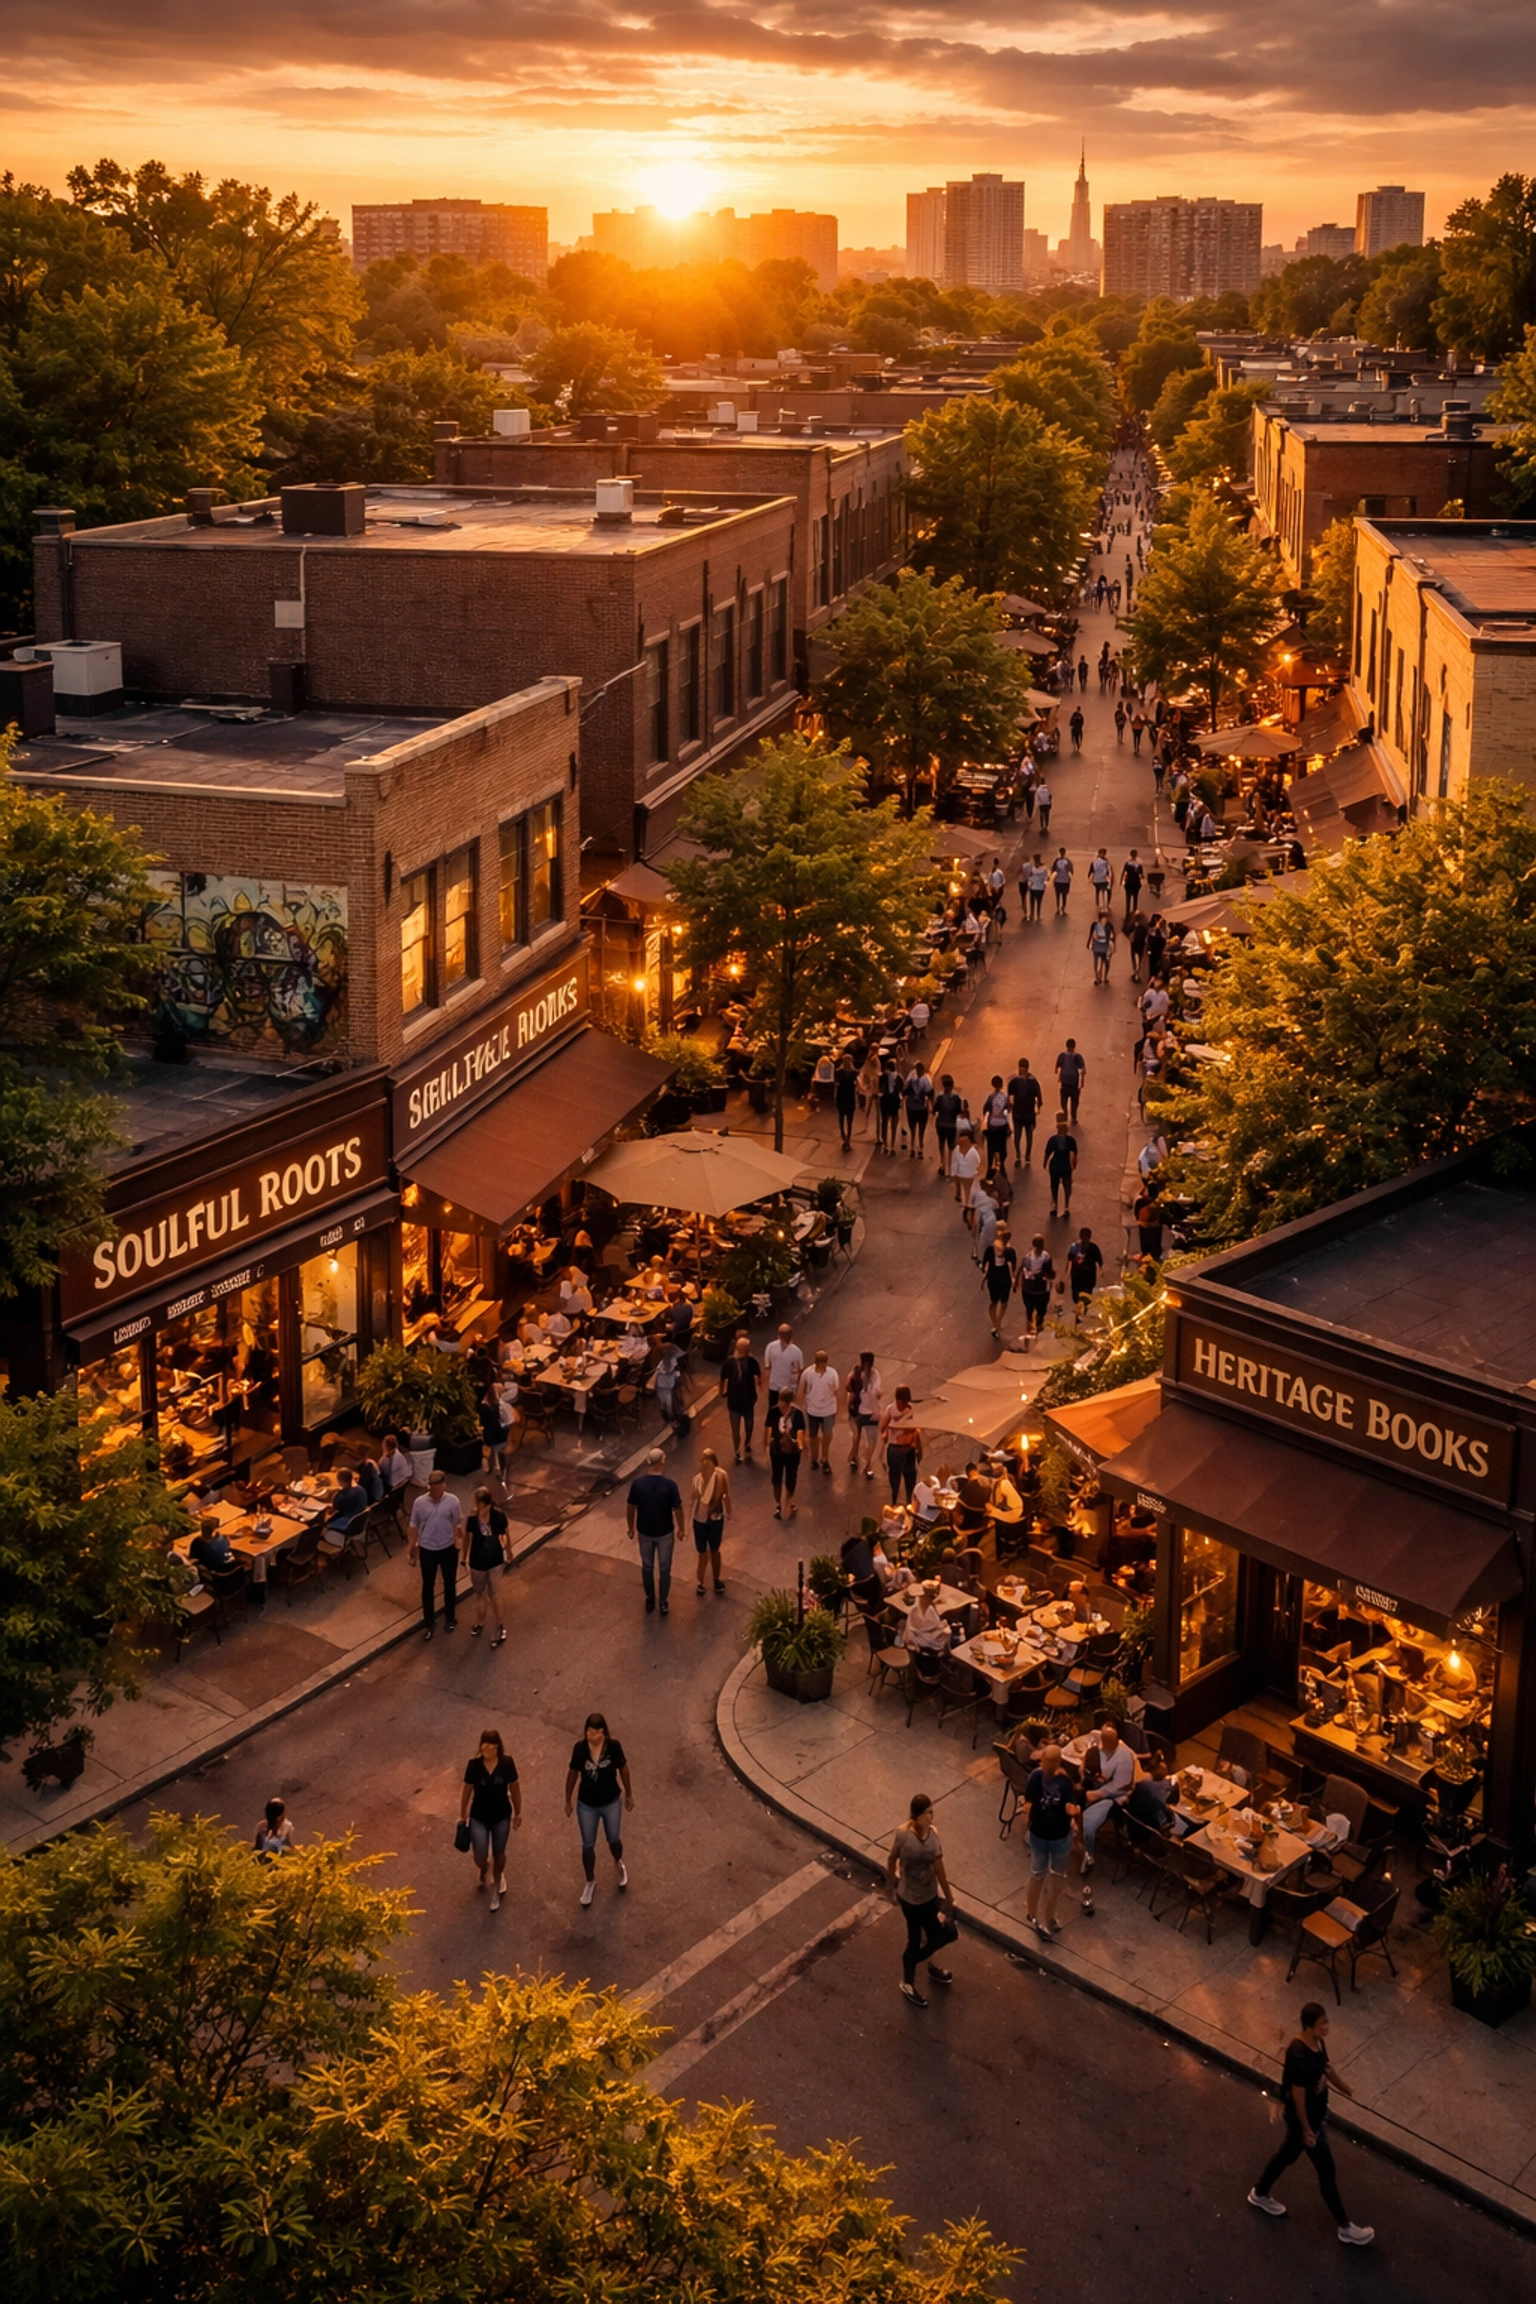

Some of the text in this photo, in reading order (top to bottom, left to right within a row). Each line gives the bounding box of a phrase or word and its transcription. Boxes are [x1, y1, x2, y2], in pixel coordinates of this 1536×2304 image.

[92, 1136, 362, 1290] SOULFUL ROOTS
[1193, 1337, 1489, 1478] HERITAGE BOOKS
